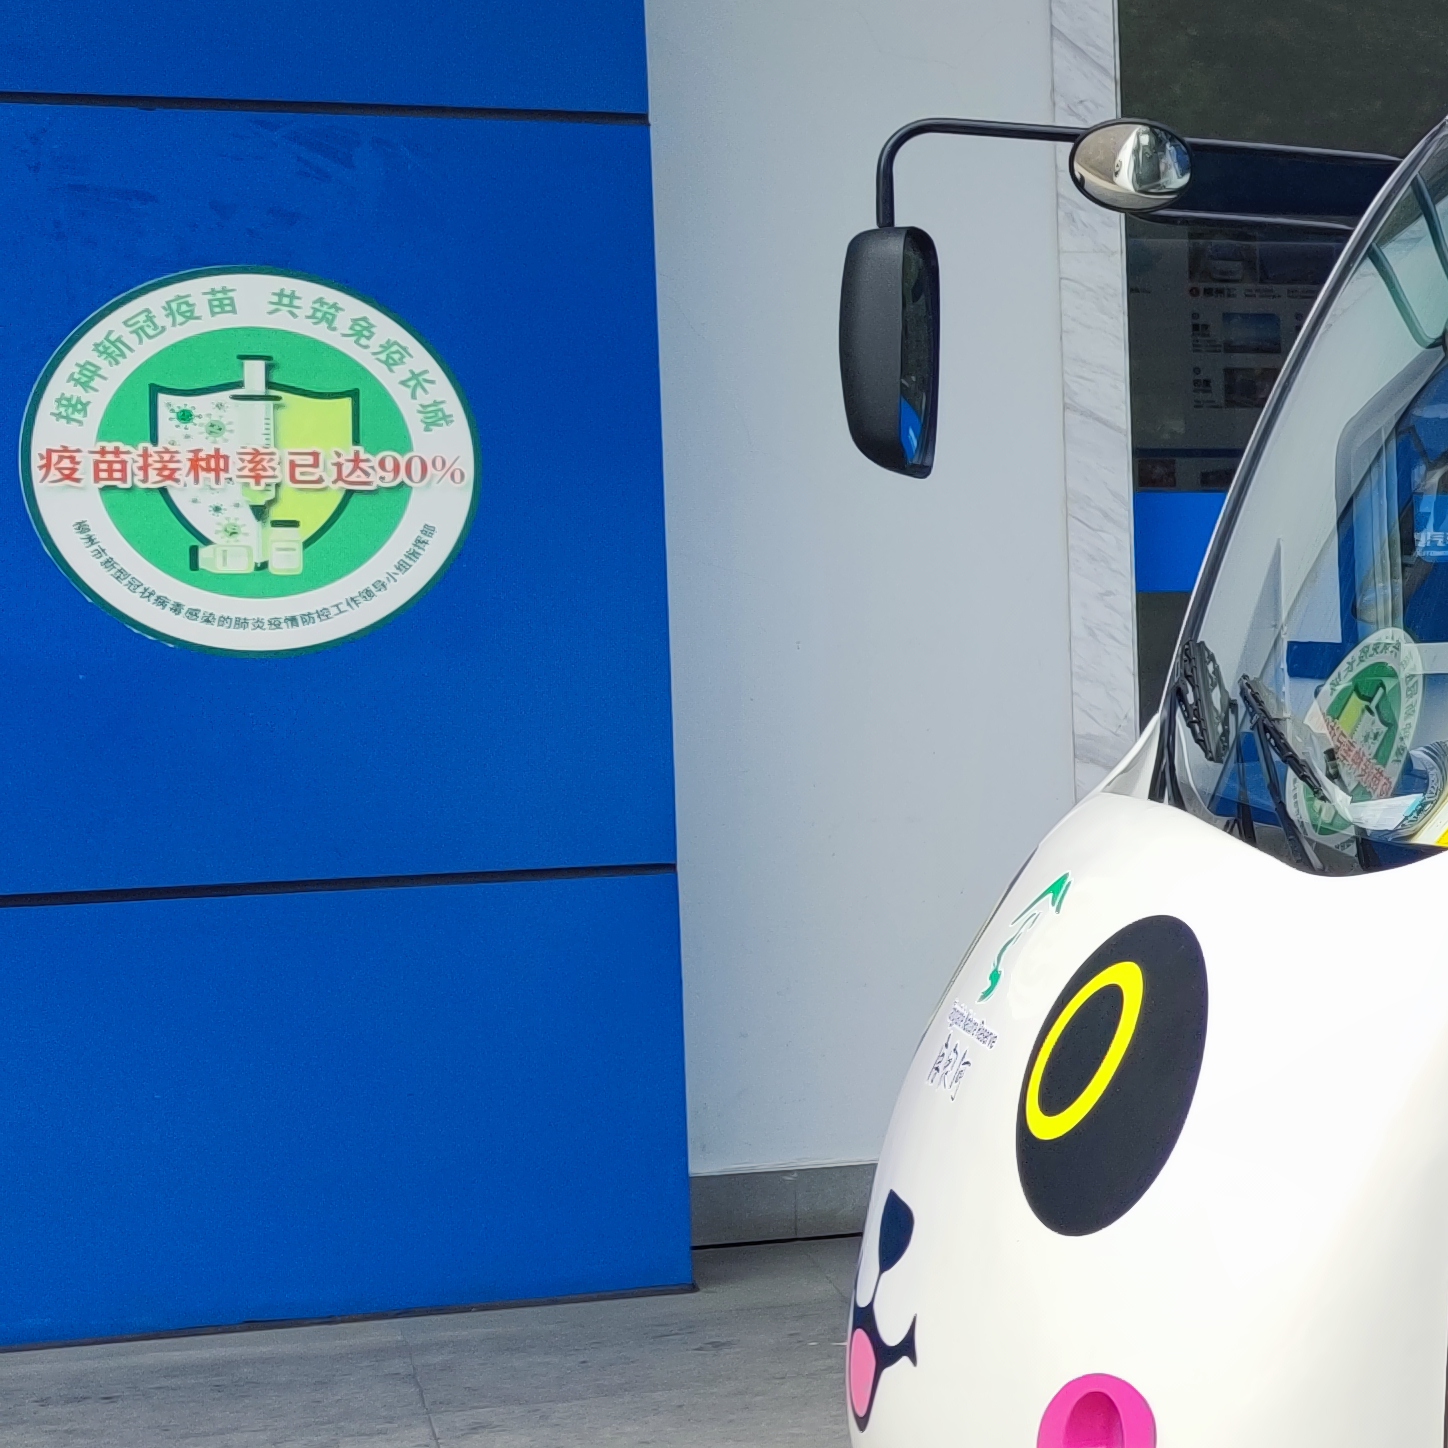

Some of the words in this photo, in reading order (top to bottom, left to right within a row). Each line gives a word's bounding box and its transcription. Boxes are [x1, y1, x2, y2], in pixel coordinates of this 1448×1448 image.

[49, 285, 238, 428] 接种新冠疫苗
[266, 288, 456, 433] 共筑免疫长城
[36, 444, 468, 486] 疫苗接种率已达90%
